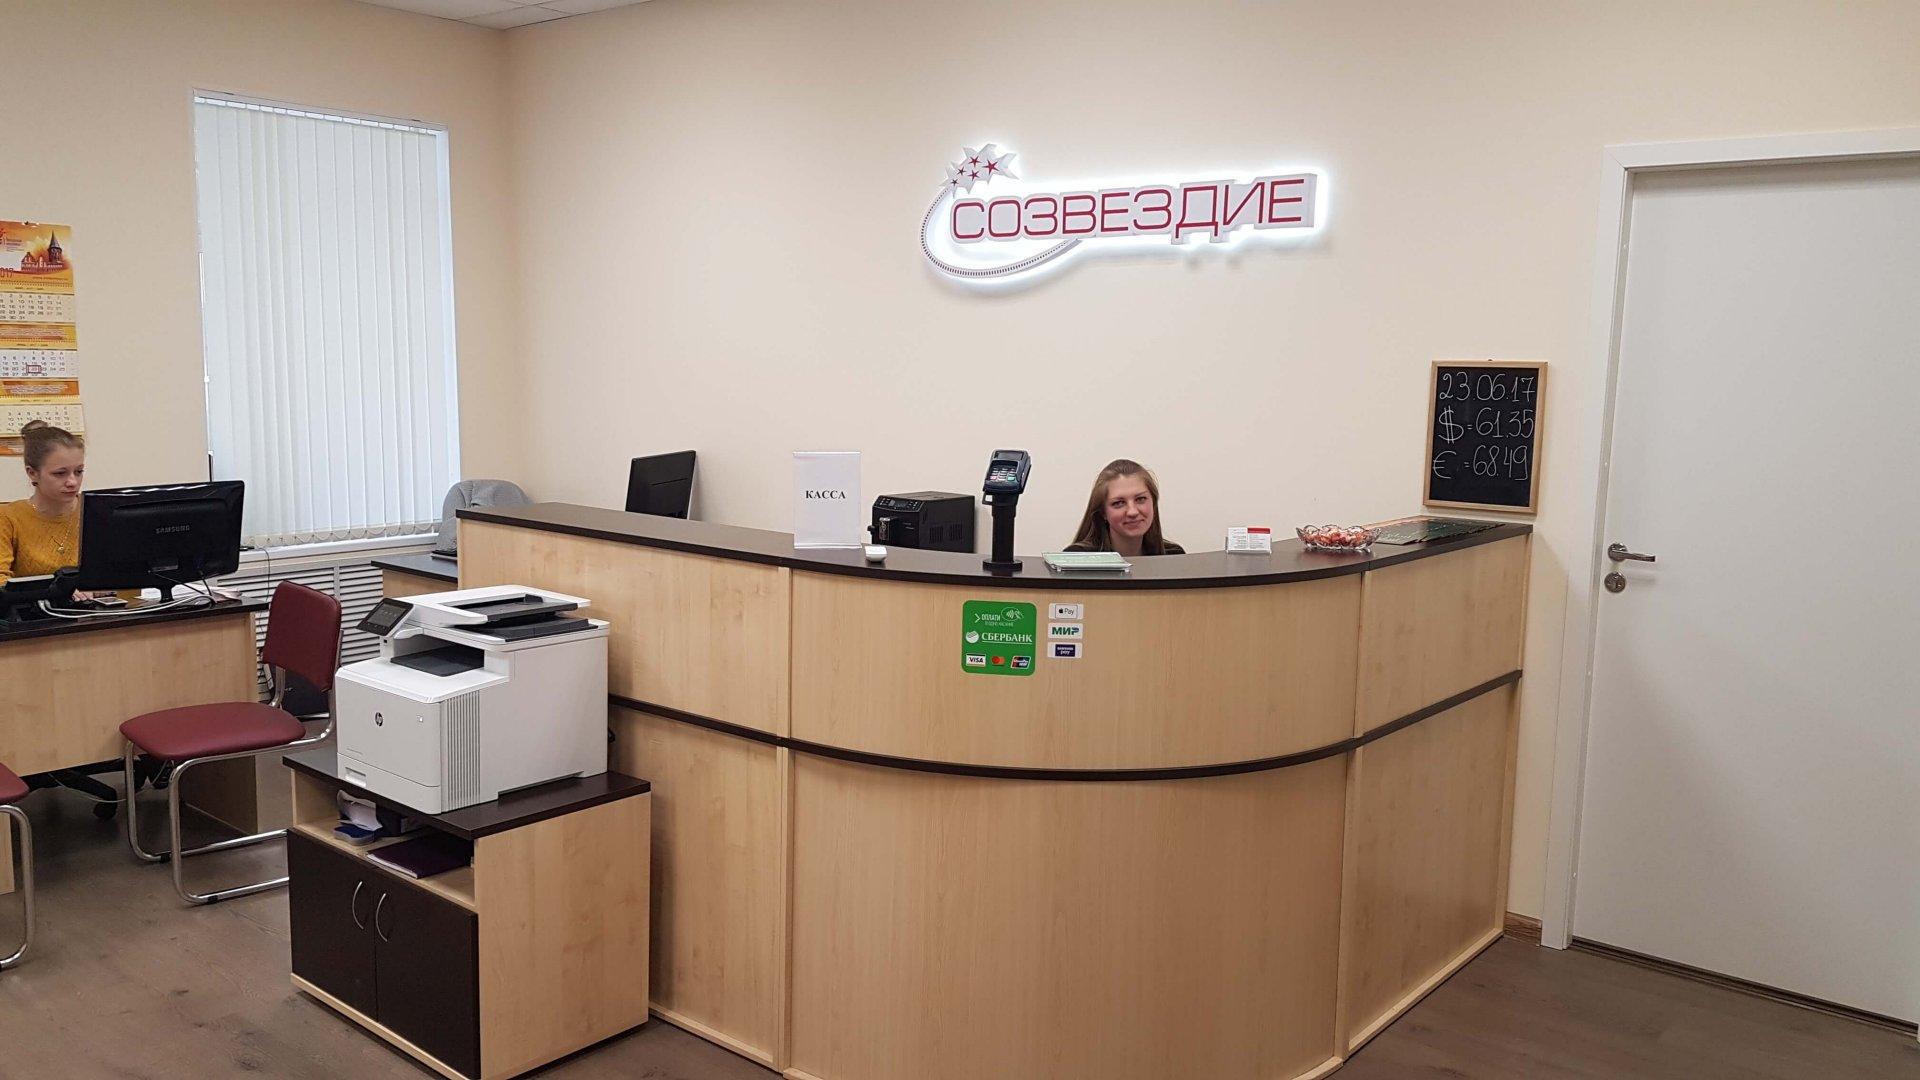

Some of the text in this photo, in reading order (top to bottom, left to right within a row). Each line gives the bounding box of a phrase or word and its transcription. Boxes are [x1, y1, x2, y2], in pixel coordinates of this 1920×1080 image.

[953, 178, 1304, 239] СОЗВЕЗДИЕ
[1439, 372, 1536, 402] 23.06.17
[805, 490, 846, 499] КАССА
[156, 525, 190, 534] SAMSUNG
[1052, 626, 1079, 635] МИР
[981, 632, 1032, 642] СБЕРБАНК
